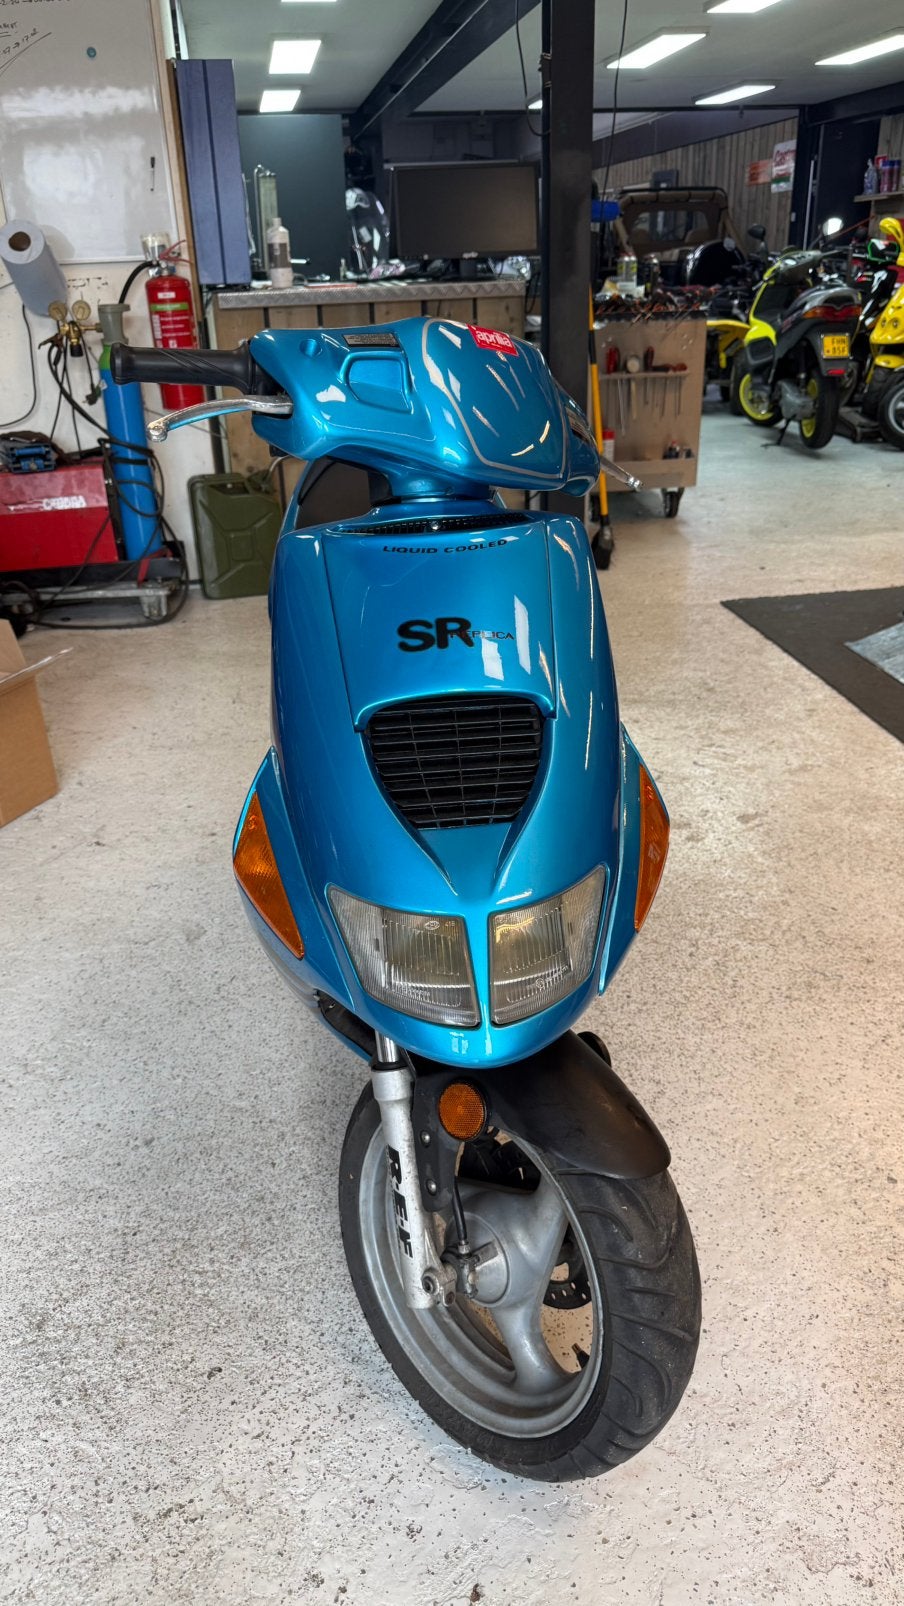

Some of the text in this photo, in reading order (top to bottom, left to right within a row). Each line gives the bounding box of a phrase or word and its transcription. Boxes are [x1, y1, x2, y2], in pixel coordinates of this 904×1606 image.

[475, 330, 513, 348] aprilia
[382, 539, 508, 554] LIQUID COOLED
[396, 616, 474, 653] SR
